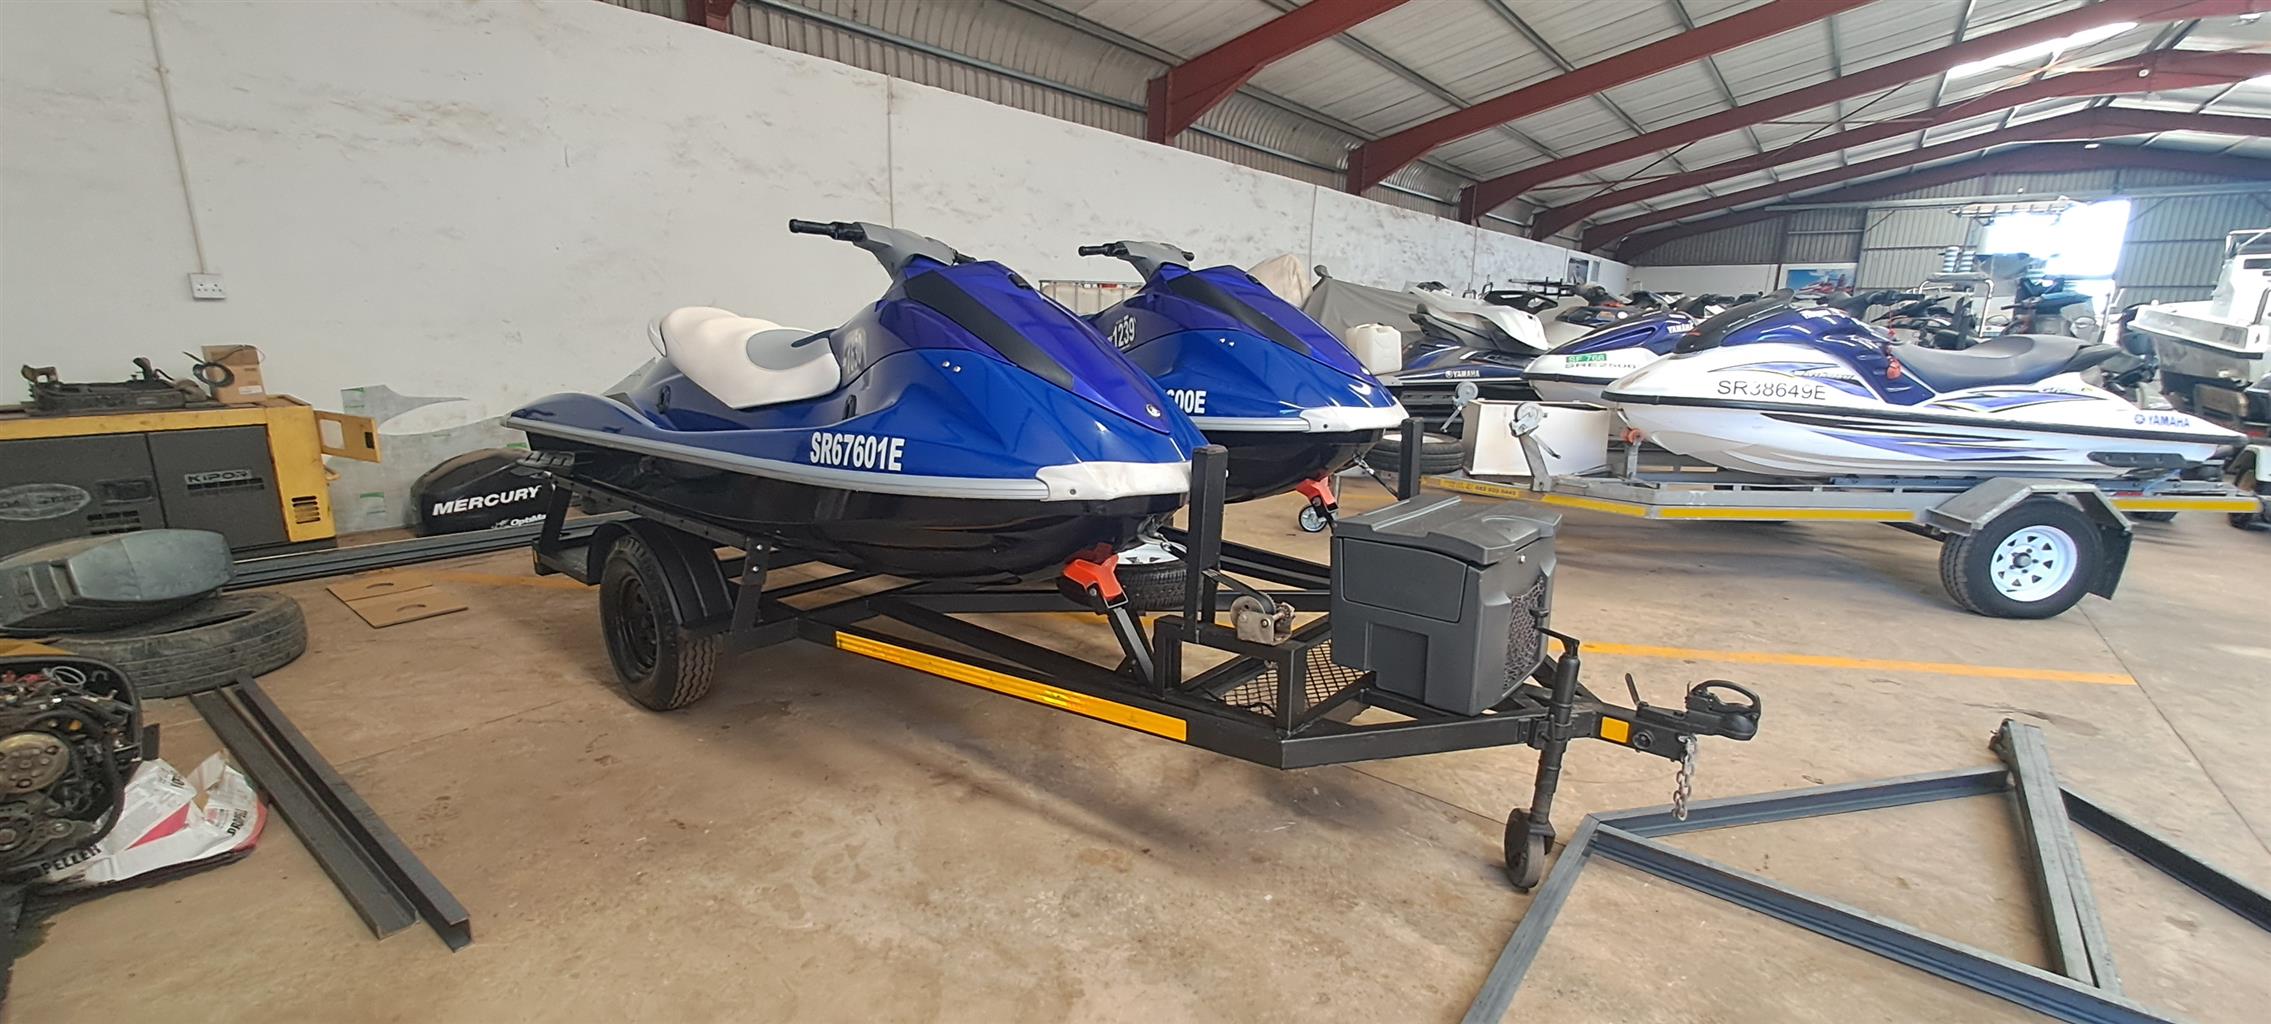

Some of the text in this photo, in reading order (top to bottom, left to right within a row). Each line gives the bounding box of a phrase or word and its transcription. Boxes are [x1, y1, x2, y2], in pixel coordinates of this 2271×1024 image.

[1717, 380, 1827, 400] SR38649E
[2149, 415, 2190, 427] YAMAHA
[810, 431, 905, 471] SR67601E
[432, 485, 542, 516] MERCURY
